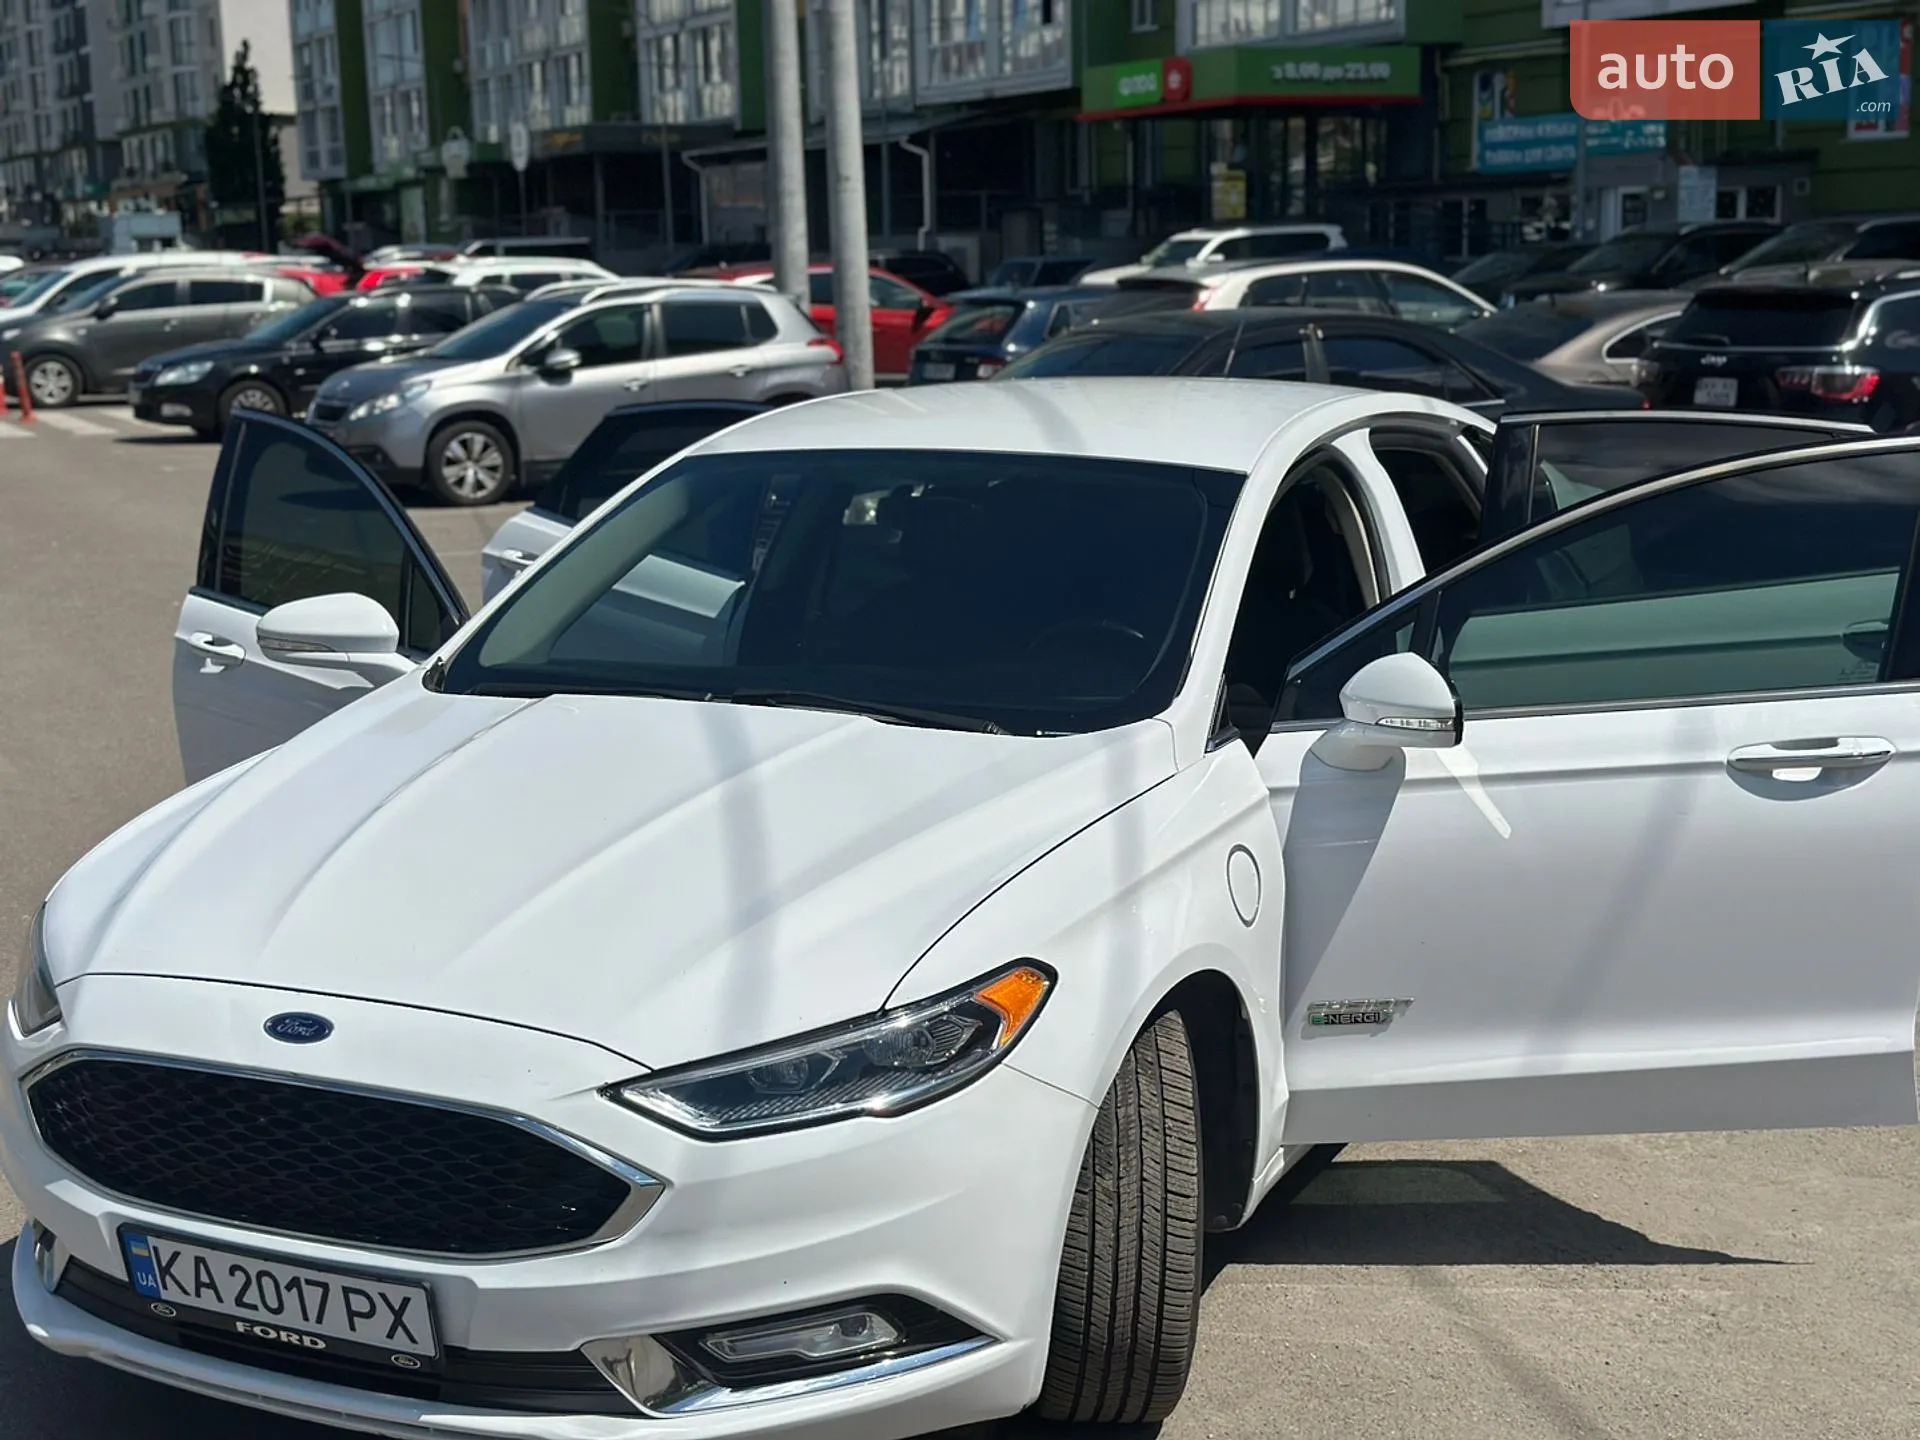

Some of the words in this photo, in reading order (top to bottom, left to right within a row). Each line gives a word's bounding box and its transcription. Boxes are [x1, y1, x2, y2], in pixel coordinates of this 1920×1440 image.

[276, 1019, 319, 1036] Ford
[136, 1271, 157, 1288] UA
[229, 1264, 330, 1324] 2017
[341, 1284, 419, 1345] PX
[236, 1321, 327, 1349] FORD
